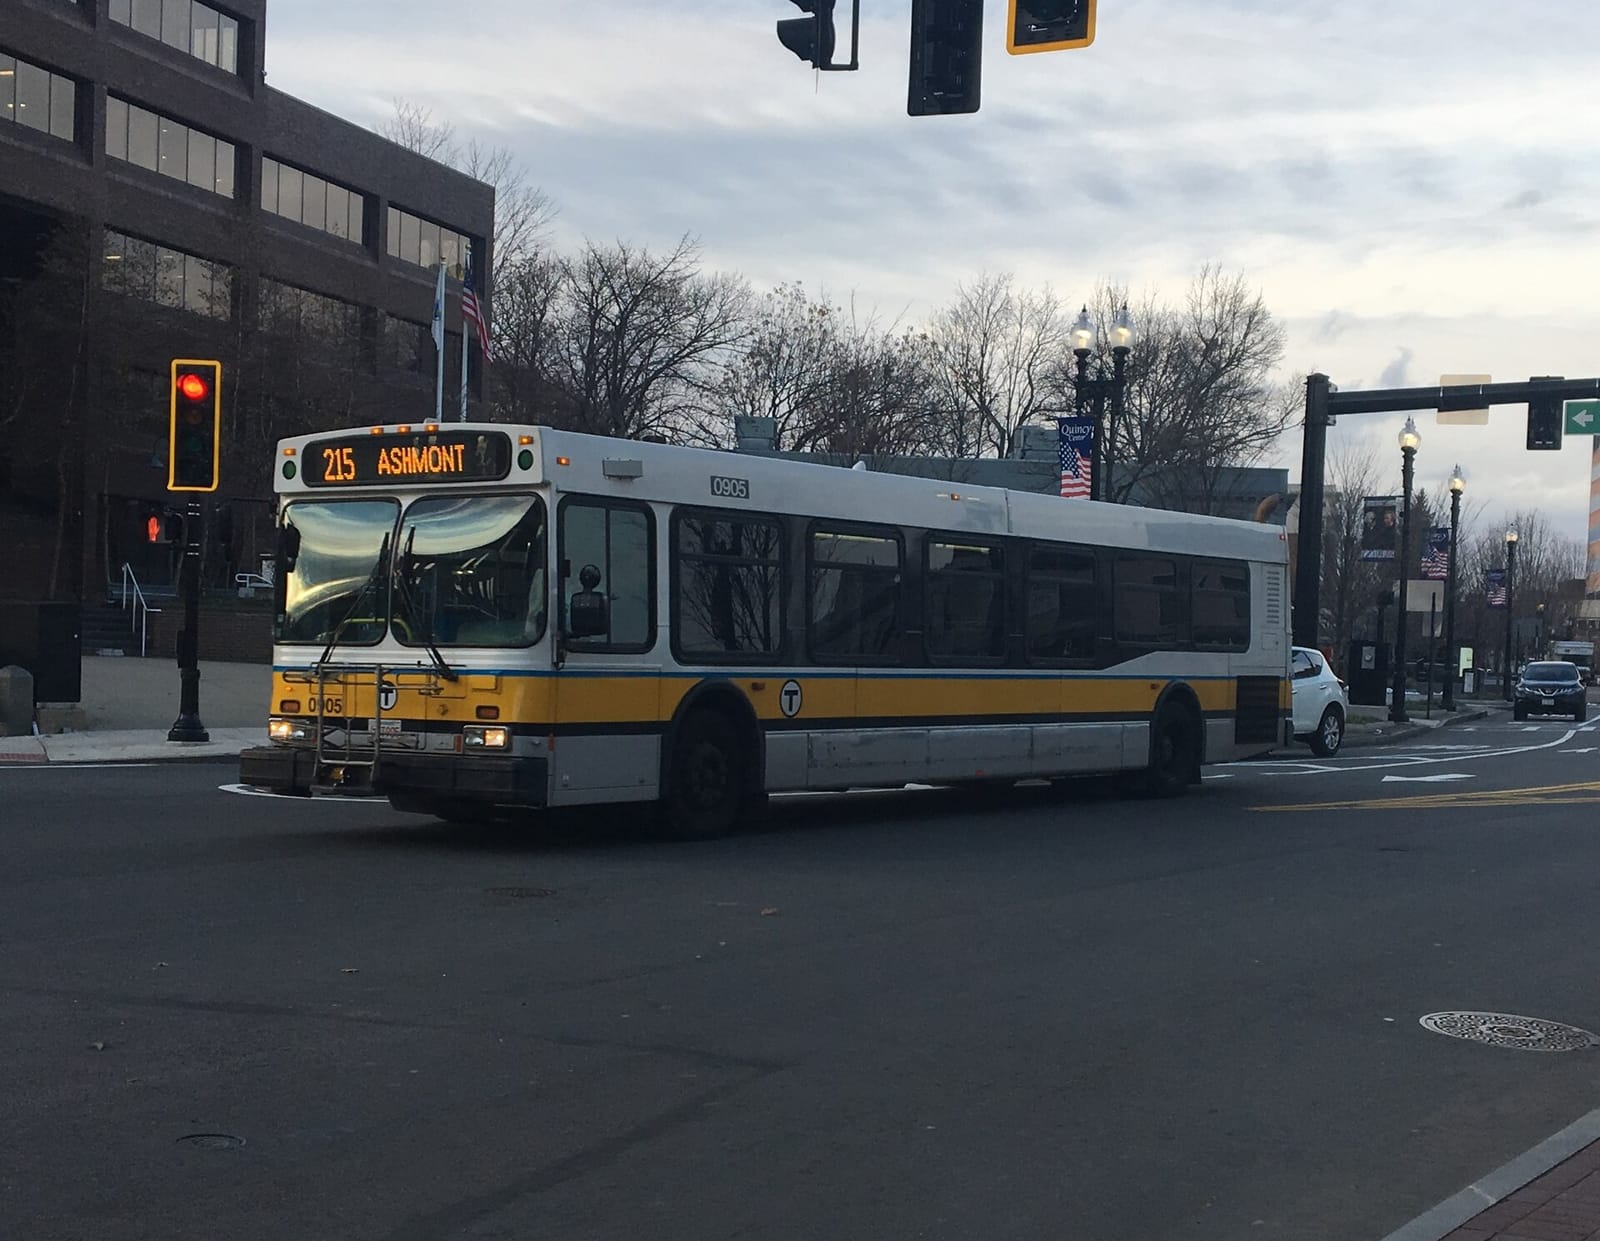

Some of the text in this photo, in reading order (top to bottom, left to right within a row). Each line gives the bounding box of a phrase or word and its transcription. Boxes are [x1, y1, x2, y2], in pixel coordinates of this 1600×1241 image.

[322, 444, 465, 481] 215 ASHMONT
[713, 477, 747, 497] 0905
[308, 697, 342, 713] 005
[784, 689, 799, 712] T
